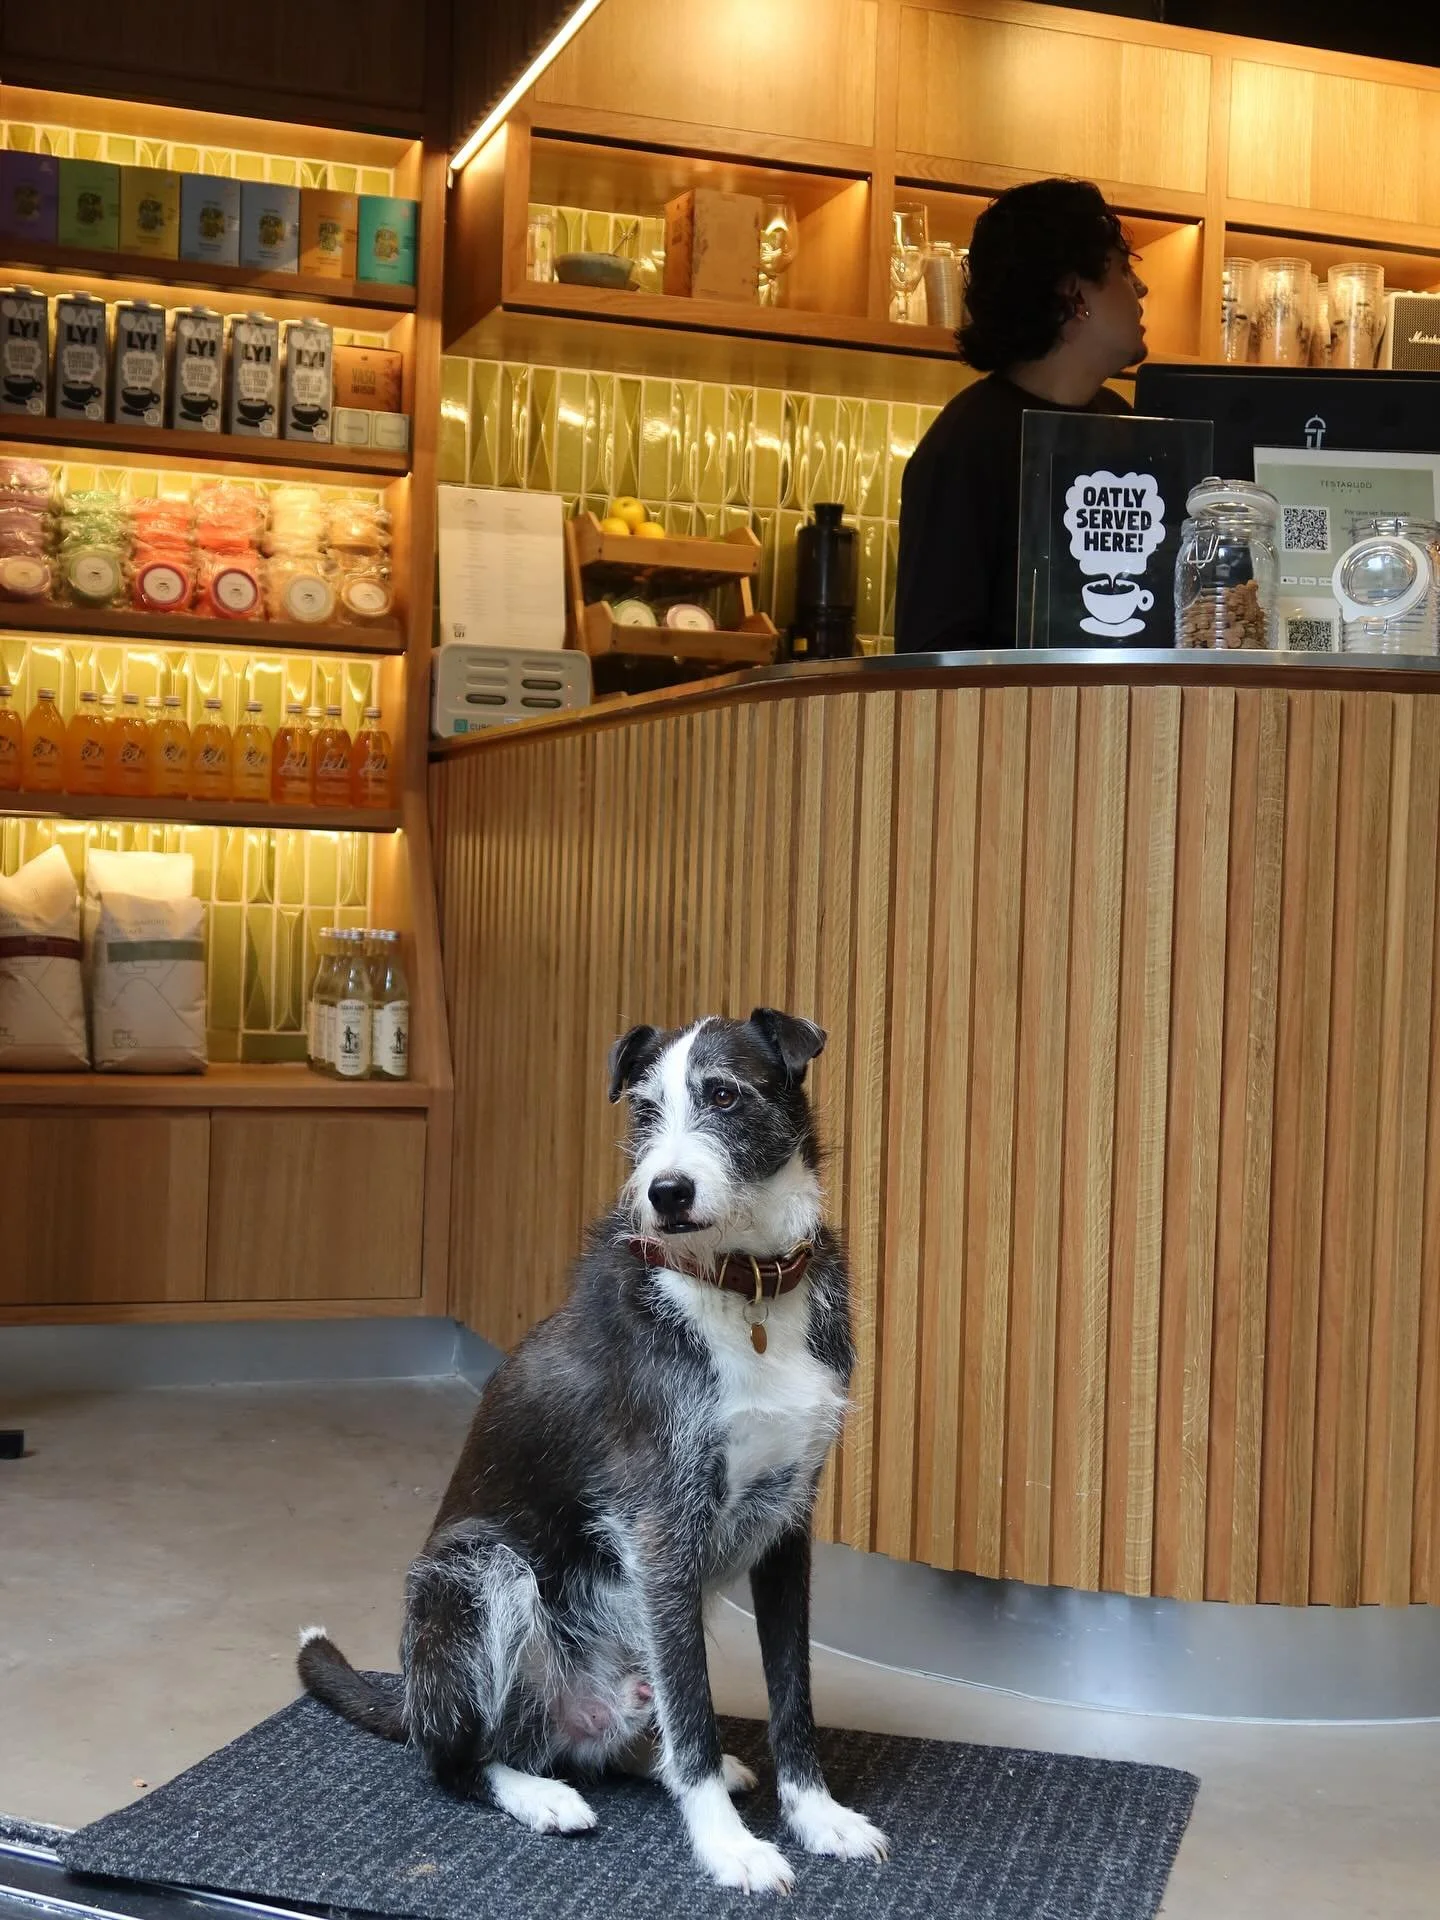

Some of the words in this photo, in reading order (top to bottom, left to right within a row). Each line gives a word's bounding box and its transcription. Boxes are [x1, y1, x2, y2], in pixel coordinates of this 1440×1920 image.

[8, 318, 40, 338] LY!
[66, 325, 98, 344] LY!
[127, 331, 157, 350] LY!
[186, 338, 216, 357] LY!
[242, 344, 271, 362] LY!
[295, 349, 325, 368] LY!
[1320, 480, 1372, 488] TESTARUDO
[1083, 486, 1146, 508] OATLY
[1076, 509, 1152, 531] SERVED
[1084, 531, 1144, 552] HERE!
